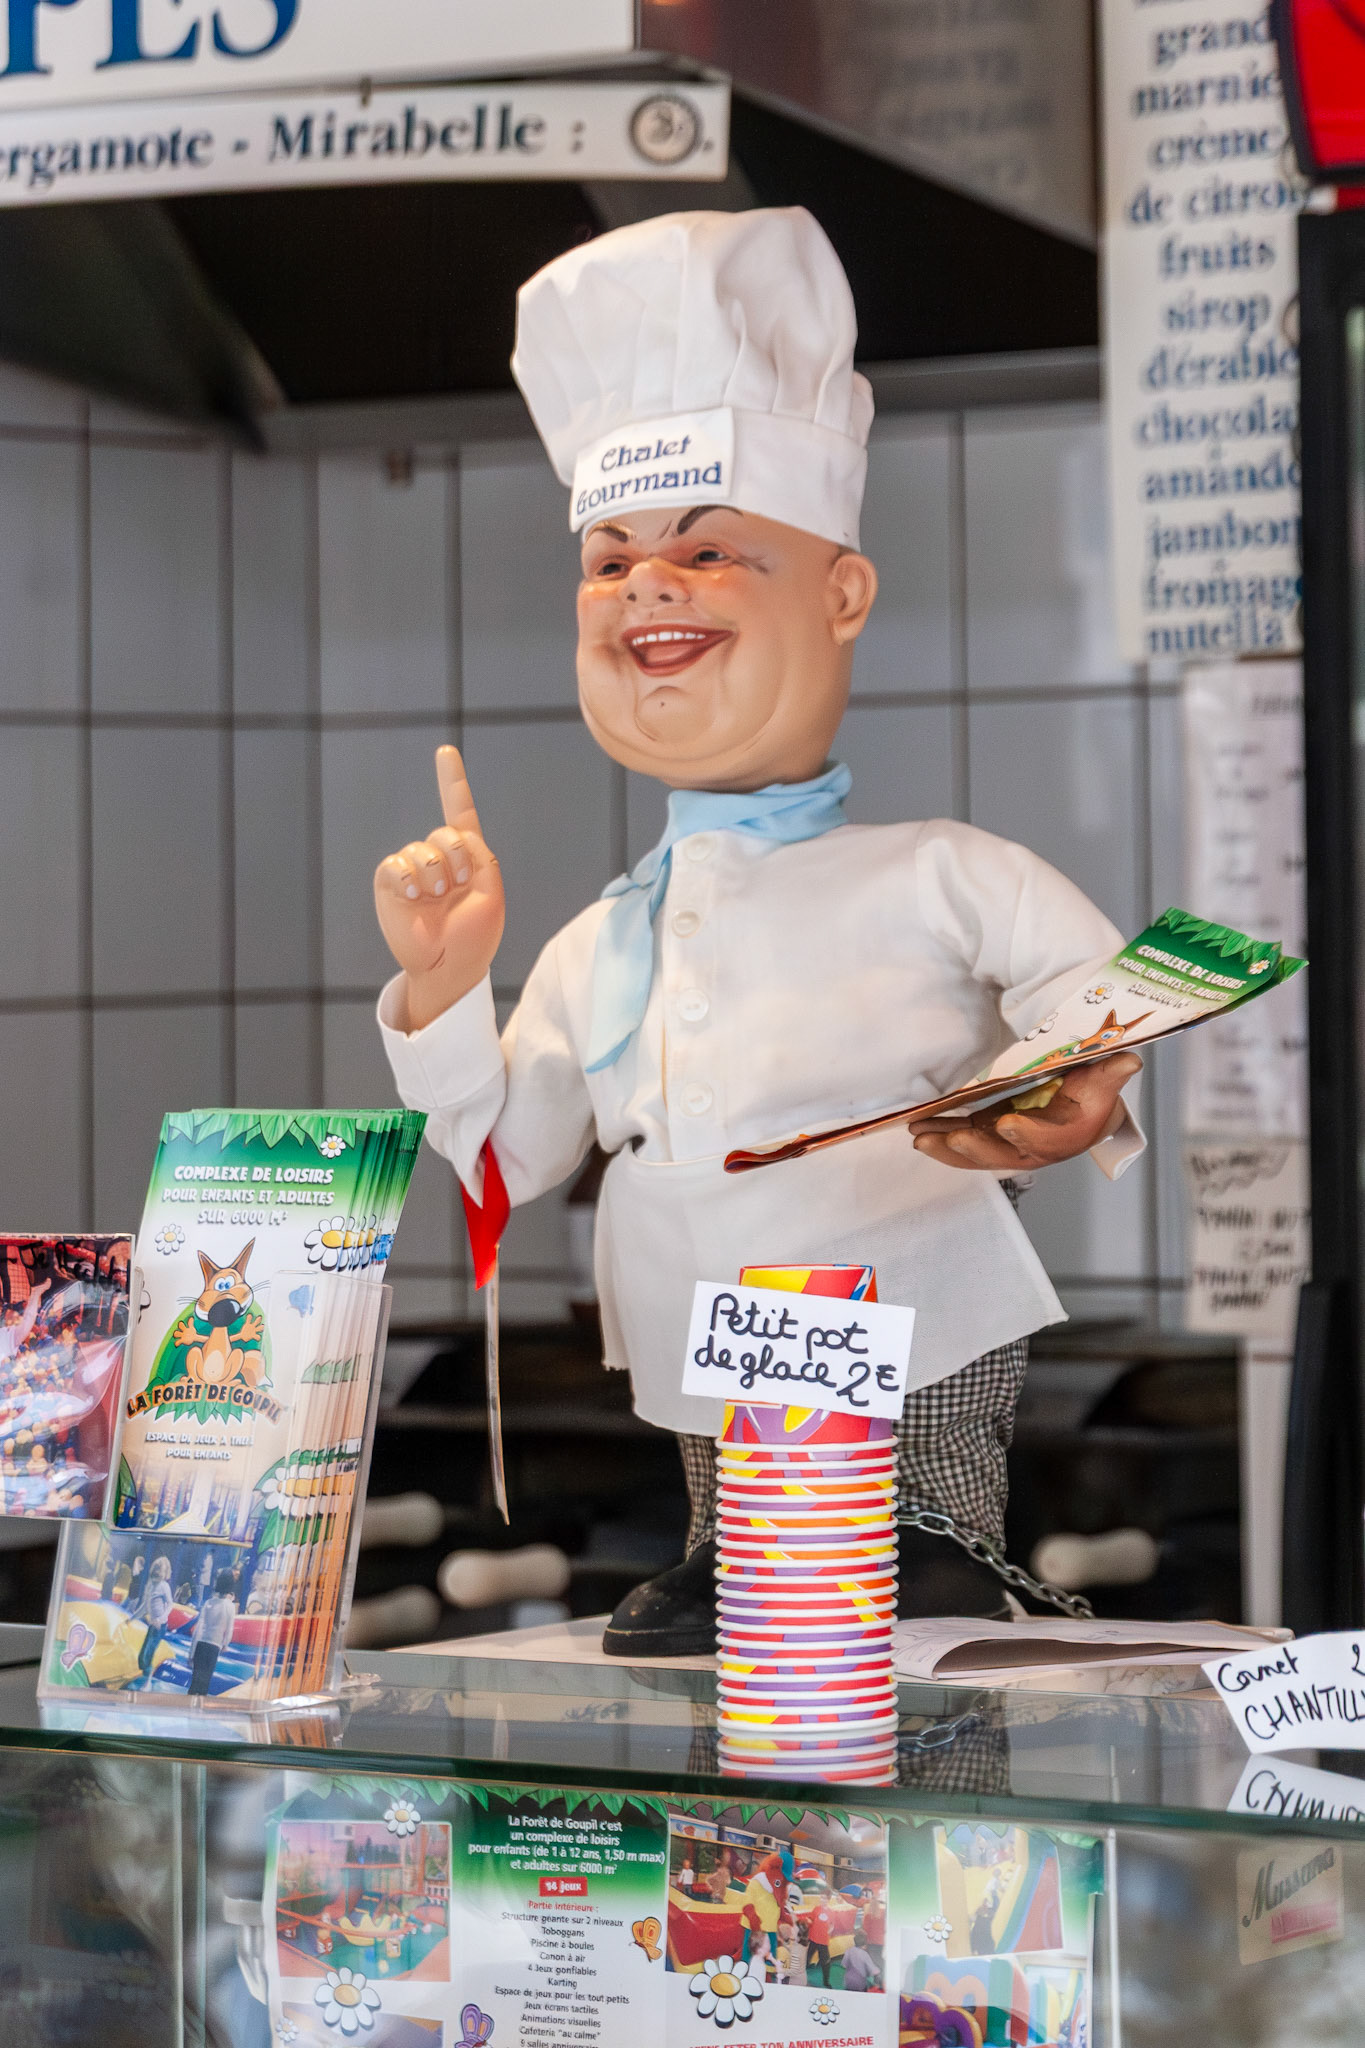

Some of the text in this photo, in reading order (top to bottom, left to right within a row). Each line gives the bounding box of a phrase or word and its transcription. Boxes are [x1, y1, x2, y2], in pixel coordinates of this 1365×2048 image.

[0, 124, 214, 190] rgamote
[267, 101, 546, 163] Mirabelle
[1160, 234, 1276, 279] fruits
[1167, 289, 1272, 335] sirop
[601, 434, 691, 473] Chalet
[576, 461, 722, 525] Gourmand
[1147, 573, 1303, 618] fromag
[1136, 945, 1193, 974] COMPLEXE
[1188, 965, 1208, 980] DE
[174, 1166, 334, 1185] COMPLEXE DE LOISIRS
[162, 1188, 335, 1207] POUR ENFANTS ET ADULTES
[197, 1208, 227, 1225] SUR
[710, 1293, 868, 1361] Petit pot
[694, 1334, 738, 1371] de
[740, 1344, 837, 1389] glace
[127, 1378, 281, 1422] LA FORÊT DE GOUPIL
[166, 1447, 192, 1460] POUR
[508, 1815, 623, 1832] La Forêt de Goupil c'est
[510, 1831, 620, 1846] un complexe de loisirs
[468, 1843, 491, 1855] pour
[493, 1842, 531, 1856] enfants
[532, 1844, 549, 1857] (de
[560, 1845, 567, 1857] à
[569, 1847, 581, 1858] 12
[582, 1849, 602, 1860] ans,
[604, 1849, 625, 1861] 1,50
[627, 1851, 637, 1862] m
[639, 1851, 666, 1865] max)
[510, 1859, 521, 1870] et
[523, 1859, 560, 1872] adultes
[561, 1863, 578, 1873] sur
[560, 1880, 582, 1893] jeux
[528, 1900, 553, 1910] Partie
[501, 1912, 539, 1922] Structure
[571, 1916, 585, 1925] sur
[593, 1917, 624, 1928] niveaux
[541, 1926, 585, 1938] Toboggans
[531, 1938, 559, 1949] Piscine
[568, 1940, 595, 1951] boules
[540, 1952, 566, 1962] Canon
[575, 1953, 586, 1963] air
[548, 1977, 578, 1990] Karting
[495, 1986, 521, 1997] Espace
[523, 1987, 532, 1997] de
[535, 1989, 552, 2000] jeux
[554, 1990, 573, 2001] pour
[588, 1993, 604, 2003] tout
[606, 1994, 630, 2005] petits
[524, 2001, 541, 2010] Jeux
[571, 2004, 599, 2015] tactiles
[521, 2014, 601, 2028] Animations visuelles
[788, 2036, 875, 2048] ANNIVERSAIRE
